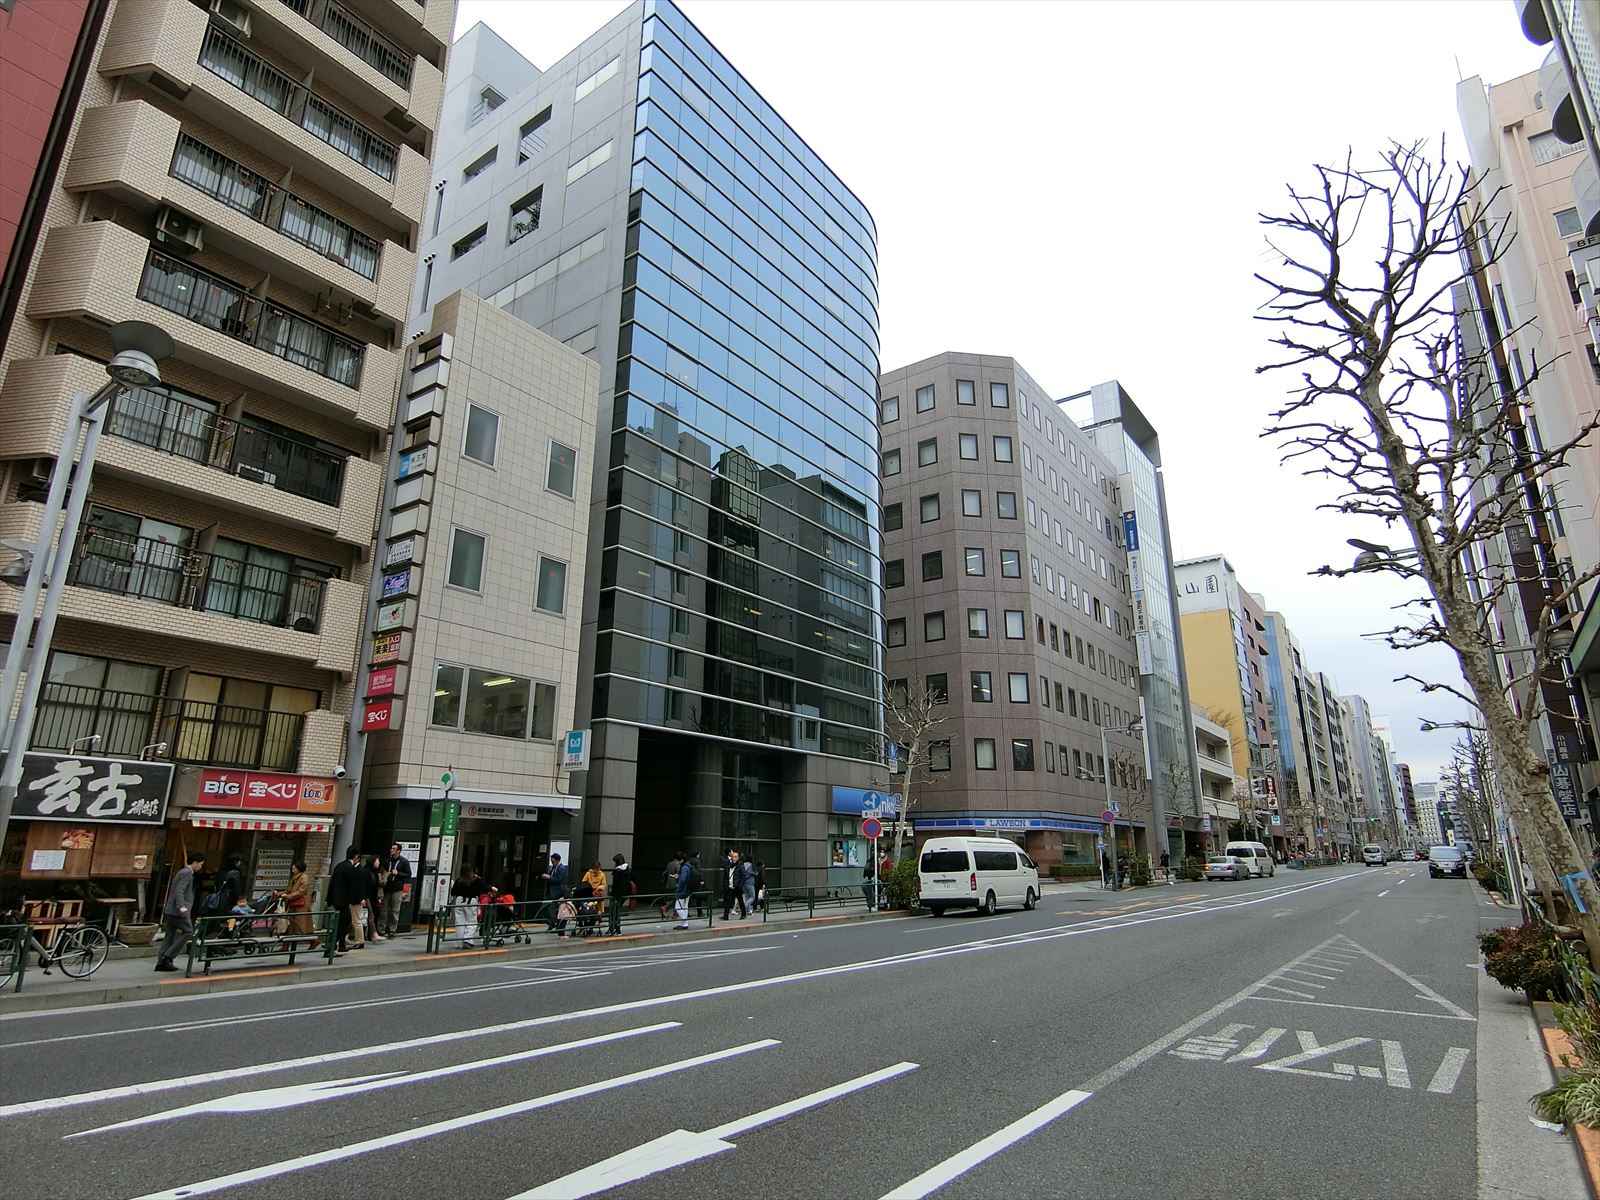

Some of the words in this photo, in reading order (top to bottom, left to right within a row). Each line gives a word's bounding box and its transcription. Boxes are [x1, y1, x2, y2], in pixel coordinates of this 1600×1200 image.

[367, 709, 388, 723] 宝くじ
[14, 760, 142, 817] 玄古
[248, 781, 297, 799] 宝くじ
[989, 819, 1027, 827] LAWSON
